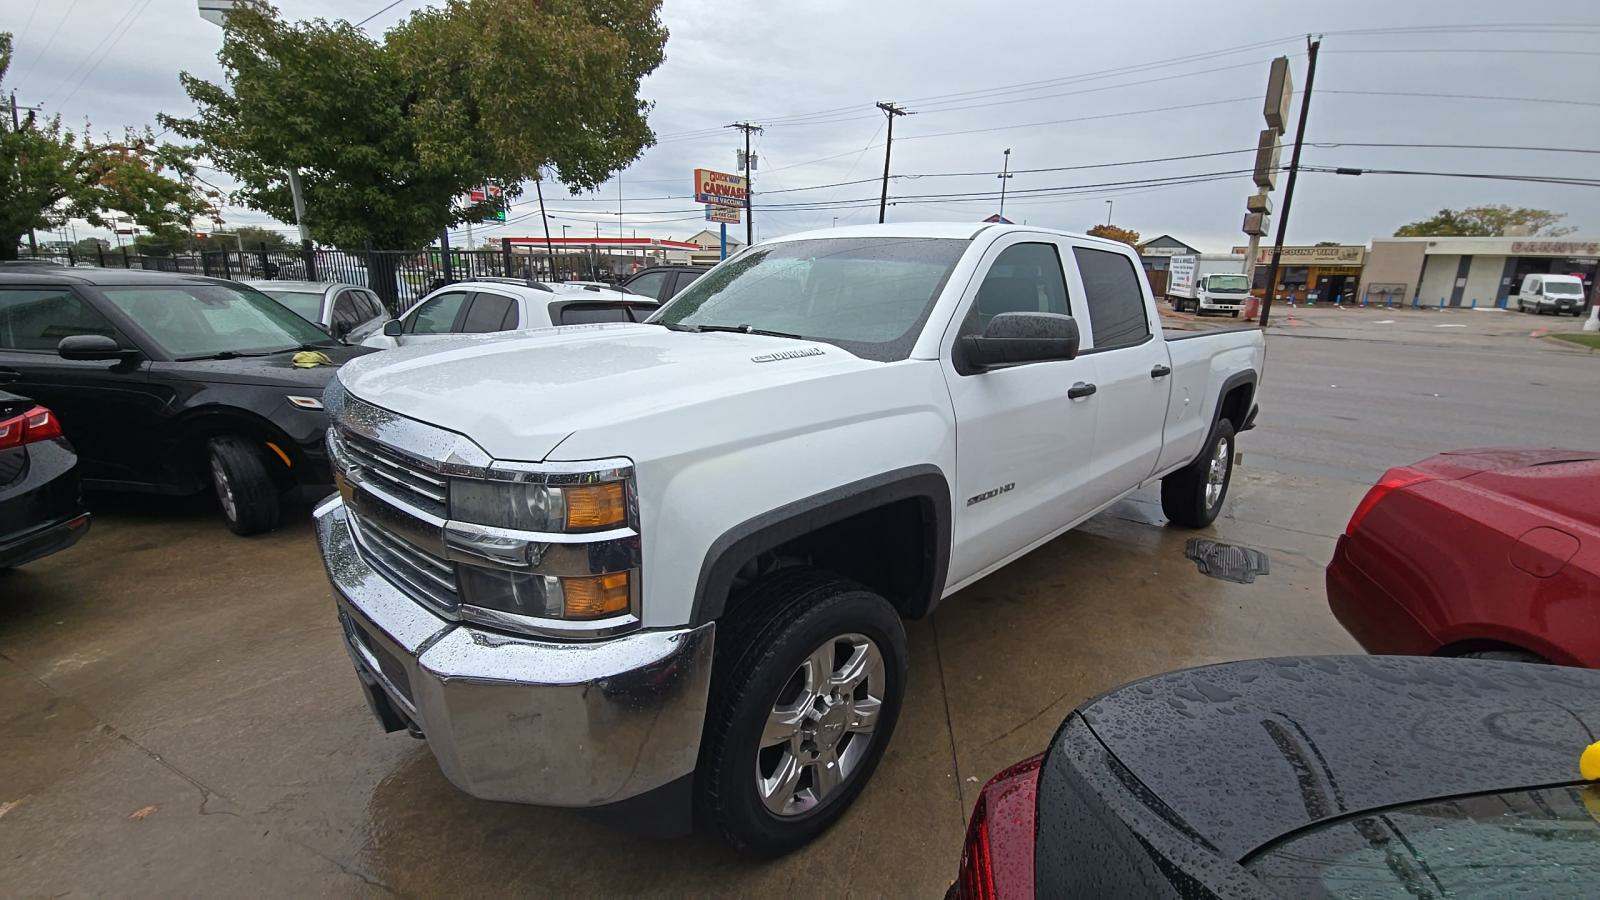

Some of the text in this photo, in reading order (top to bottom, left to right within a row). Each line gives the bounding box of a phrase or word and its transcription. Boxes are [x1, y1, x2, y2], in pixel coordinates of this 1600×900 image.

[703, 182, 747, 199] CARWASH
[967, 482, 1016, 507] 2500 HD
